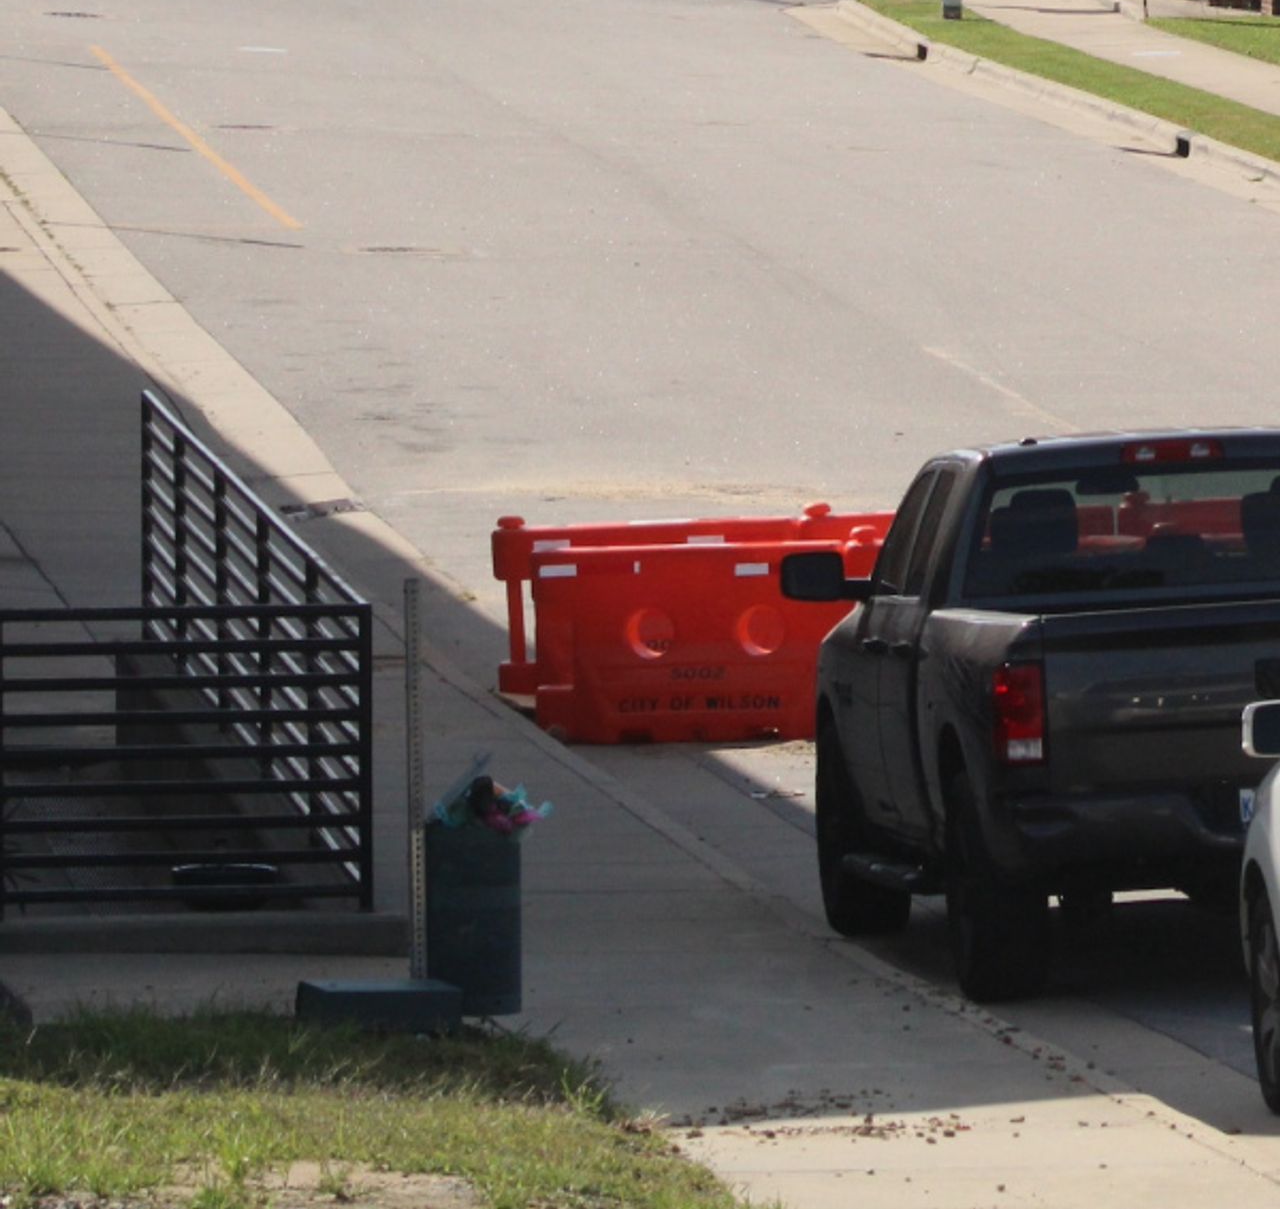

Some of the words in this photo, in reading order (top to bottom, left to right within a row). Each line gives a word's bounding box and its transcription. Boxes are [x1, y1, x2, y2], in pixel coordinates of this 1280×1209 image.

[618, 697, 658, 713] CITY
[670, 696, 695, 711] OF
[705, 695, 781, 711] WILSON
